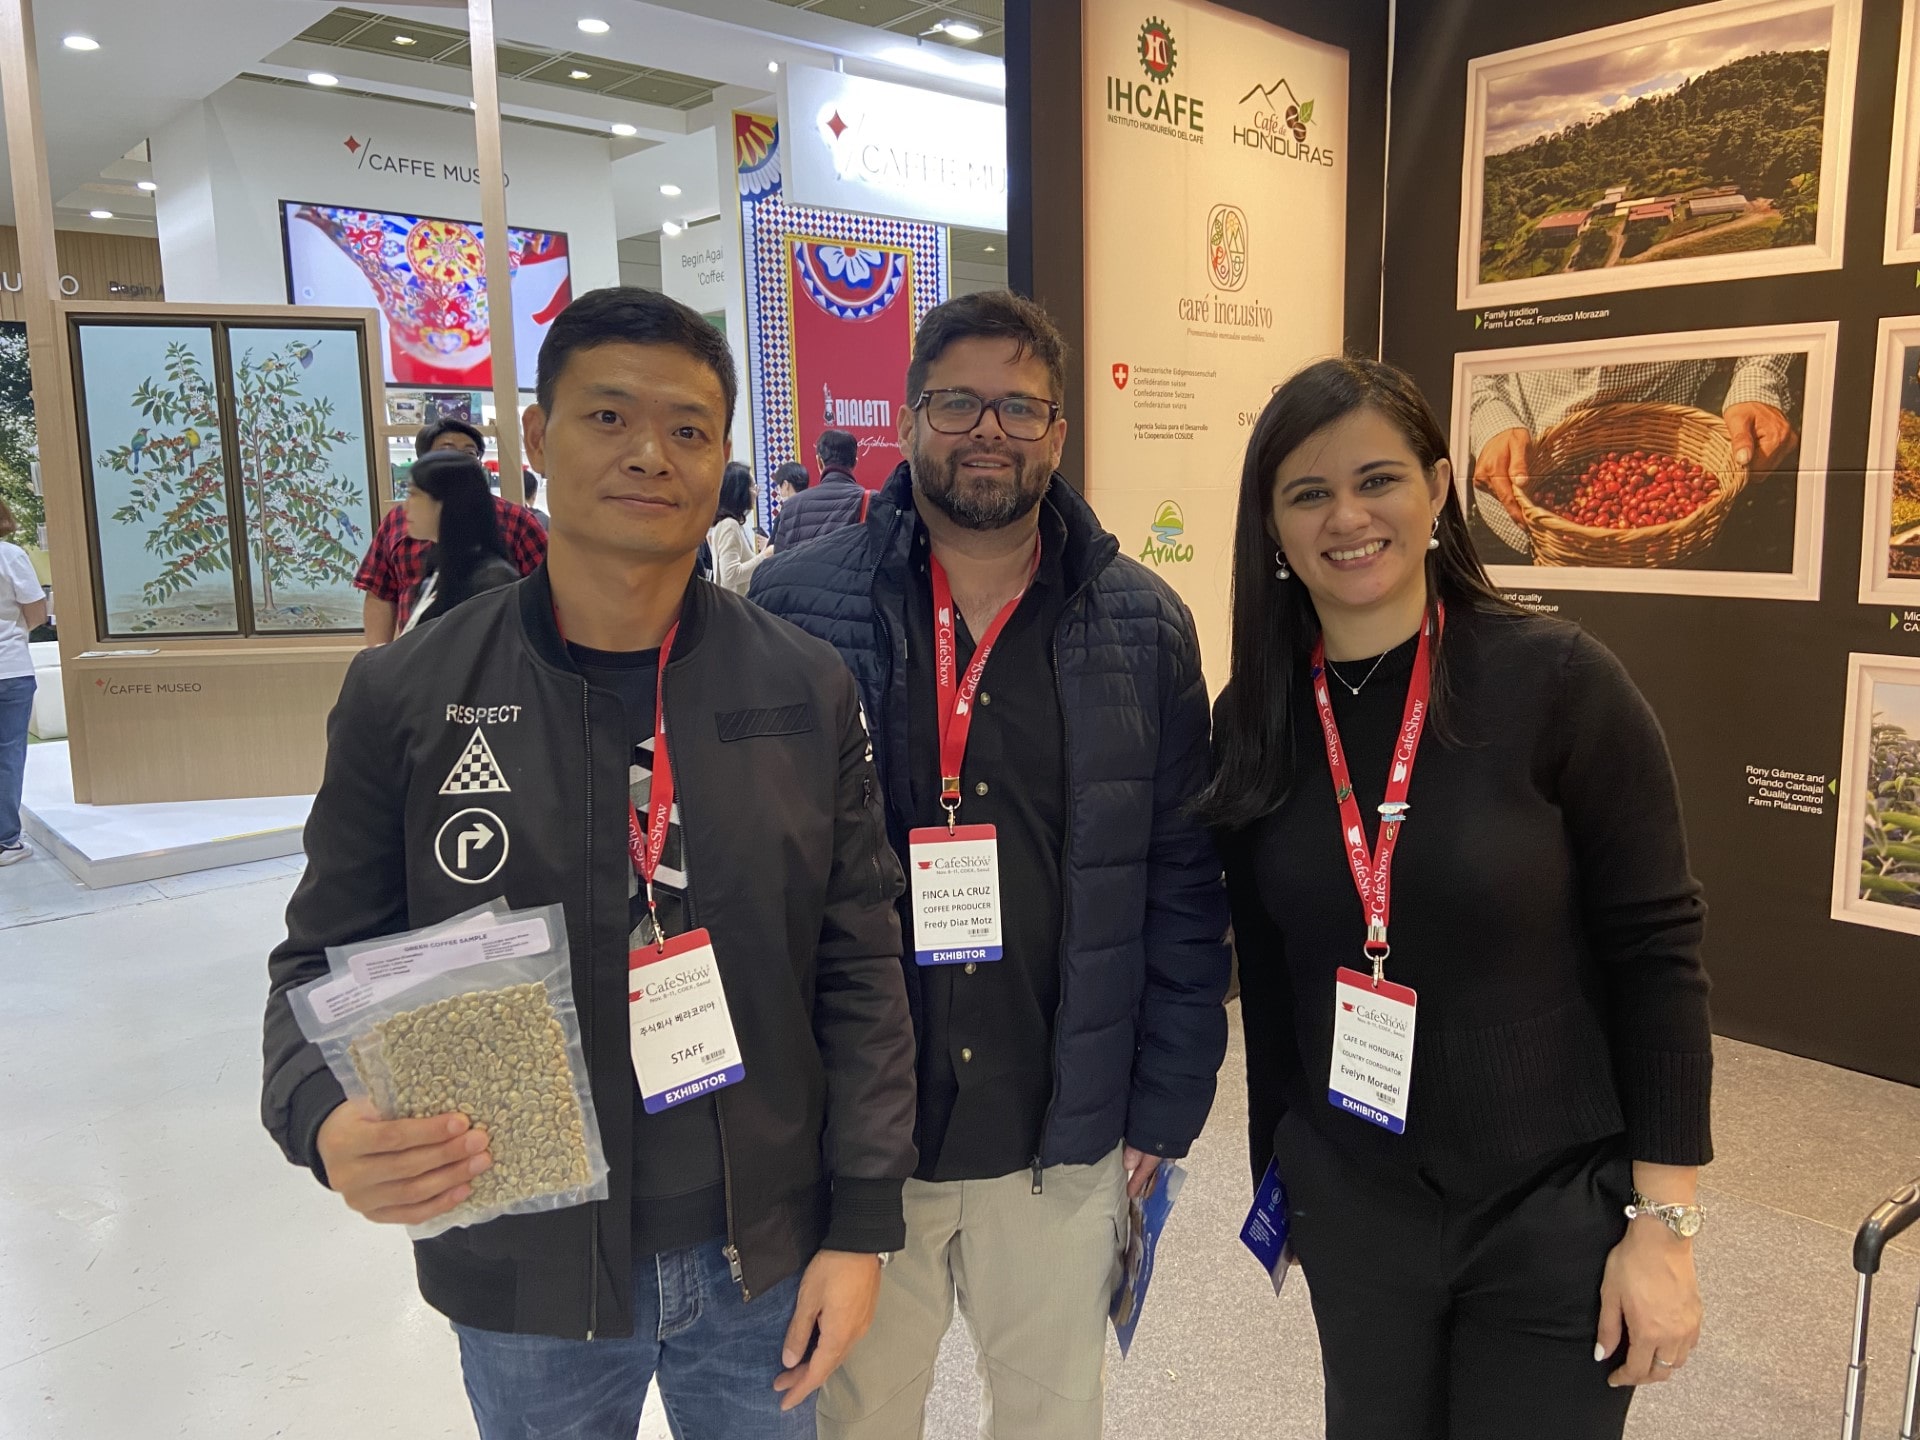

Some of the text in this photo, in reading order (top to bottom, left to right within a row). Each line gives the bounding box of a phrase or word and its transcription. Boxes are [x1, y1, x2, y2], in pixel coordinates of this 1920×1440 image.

[1107, 76, 1204, 132] IHCAFE
[1108, 114, 1139, 128] INSTITUTO
[1139, 121, 1177, 138] HONDUREÑO
[1177, 130, 1189, 140] DEL
[1254, 111, 1279, 138] Café
[1233, 125, 1334, 167] HONDURAS
[369, 153, 510, 188] CAFFE MUS
[681, 254, 705, 269] Begin
[1483, 306, 1539, 322] Family tradition
[1483, 308, 1610, 330] Farm La Cruz, Francisco Morazan
[1133, 431, 1195, 441] y la Cooperación COSUDE
[1134, 422, 1209, 432] Agencia Suiza para el Desarrollo
[1518, 593, 1543, 604] quality
[939, 628, 953, 688] CafeShow
[961, 645, 992, 700] CafeShow
[110, 682, 202, 696] CAFFE MUSEO
[445, 703, 522, 725] RESPECT
[1322, 707, 1340, 767] CafeShow
[1397, 699, 1424, 761] CafeShow
[1745, 765, 1825, 784] Rony Gámez and
[1747, 776, 1825, 795] Orlando Carbajal
[1747, 796, 1823, 815] Farm Platanares
[1759, 787, 1824, 805] Quality control
[934, 855, 990, 870] CafeShow
[1370, 847, 1390, 913] CafeShow
[922, 886, 991, 900] FINCA LA CRUZ
[923, 902, 991, 914] COFFEE PRODUCER
[924, 917, 993, 929] Fredy Diaz Motz
[404, 943, 429, 952] GREEN
[430, 939, 459, 948] COFFEE
[459, 933, 488, 944] SAMPLE
[932, 949, 987, 962] EXHIBITOR
[645, 968, 710, 997] CafeShow
[639, 1012, 673, 1037] 주식회사
[1356, 1004, 1408, 1032] CafeShow
[670, 1042, 705, 1065] STAFF
[1343, 1033, 1404, 1062] CAFE DE HONDURAS
[1340, 1064, 1367, 1081] Evelyn
[1342, 1049, 1402, 1077] COUNTRY COORDINATOR
[664, 1072, 727, 1104] EXHIBITOR
[1342, 1097, 1390, 1126] EXHIBITOR
